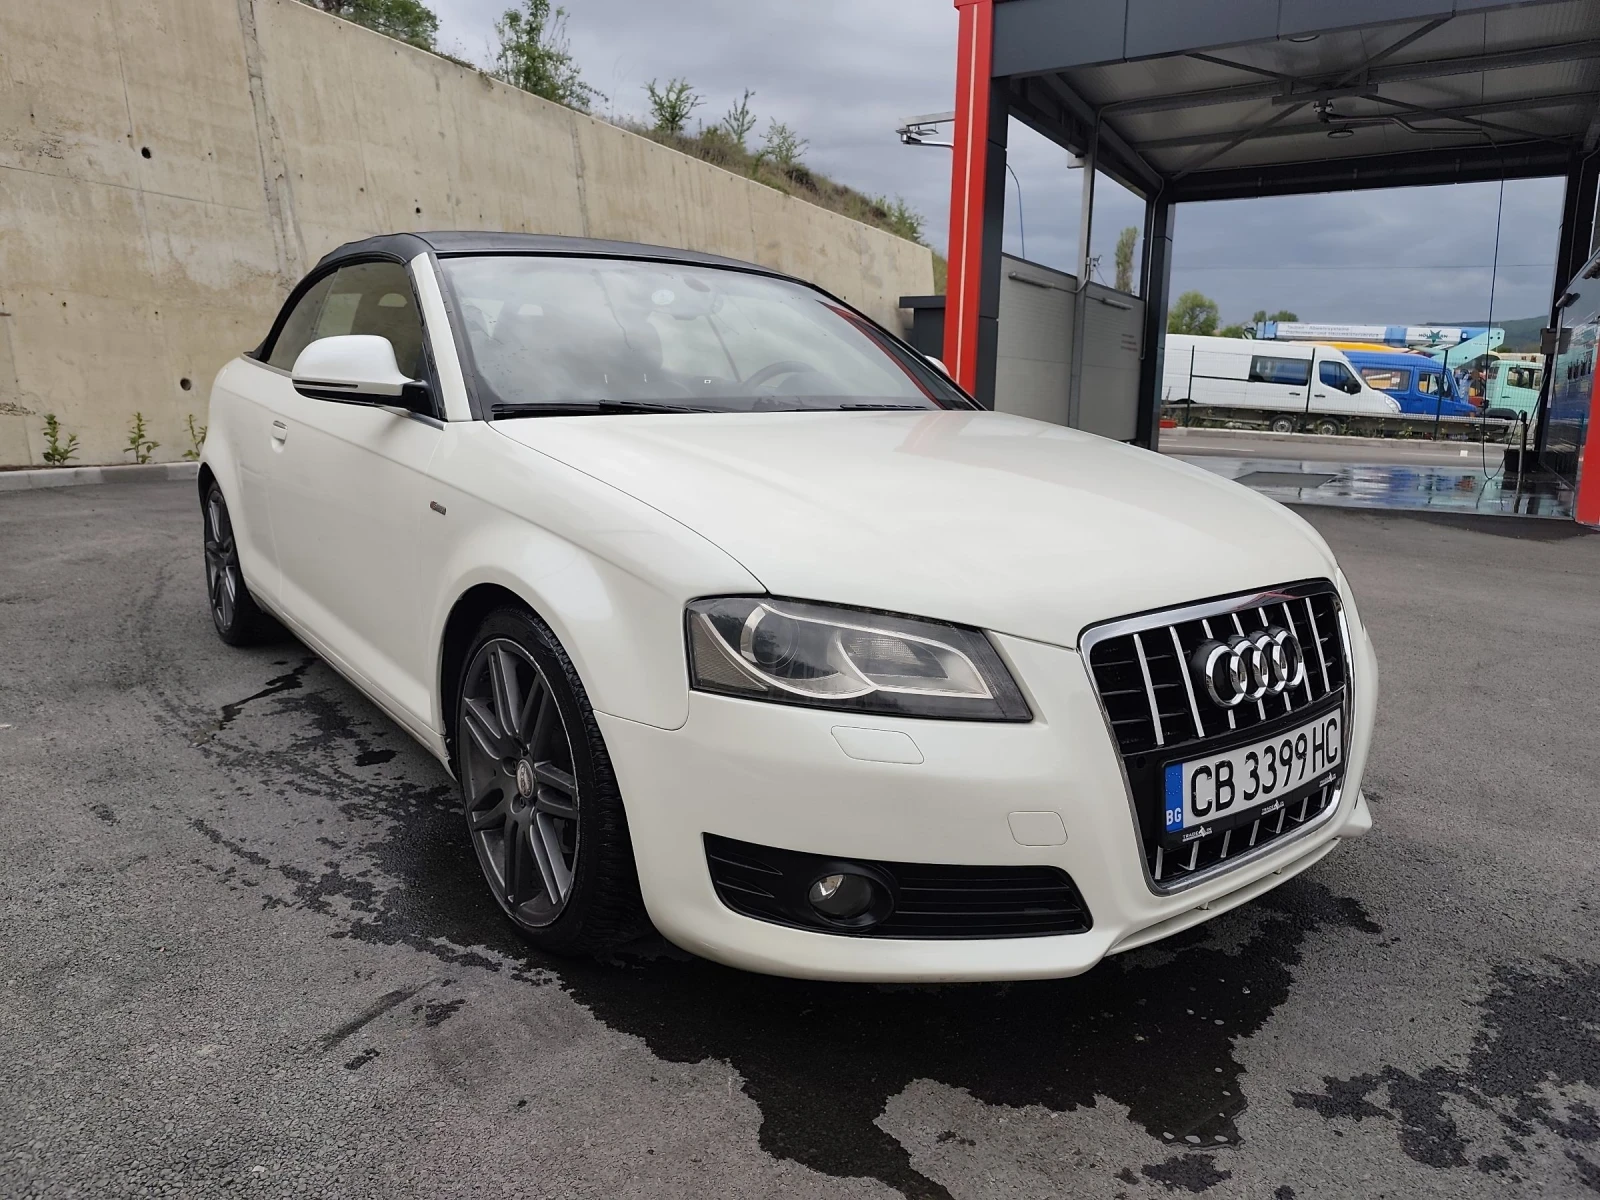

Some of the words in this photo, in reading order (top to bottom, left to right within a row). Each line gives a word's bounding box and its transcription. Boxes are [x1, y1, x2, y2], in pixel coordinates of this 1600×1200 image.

[1191, 759, 1235, 817] CB
[1243, 732, 1308, 801] 3399
[1312, 717, 1338, 773] HC
[1166, 807, 1182, 826] BG
